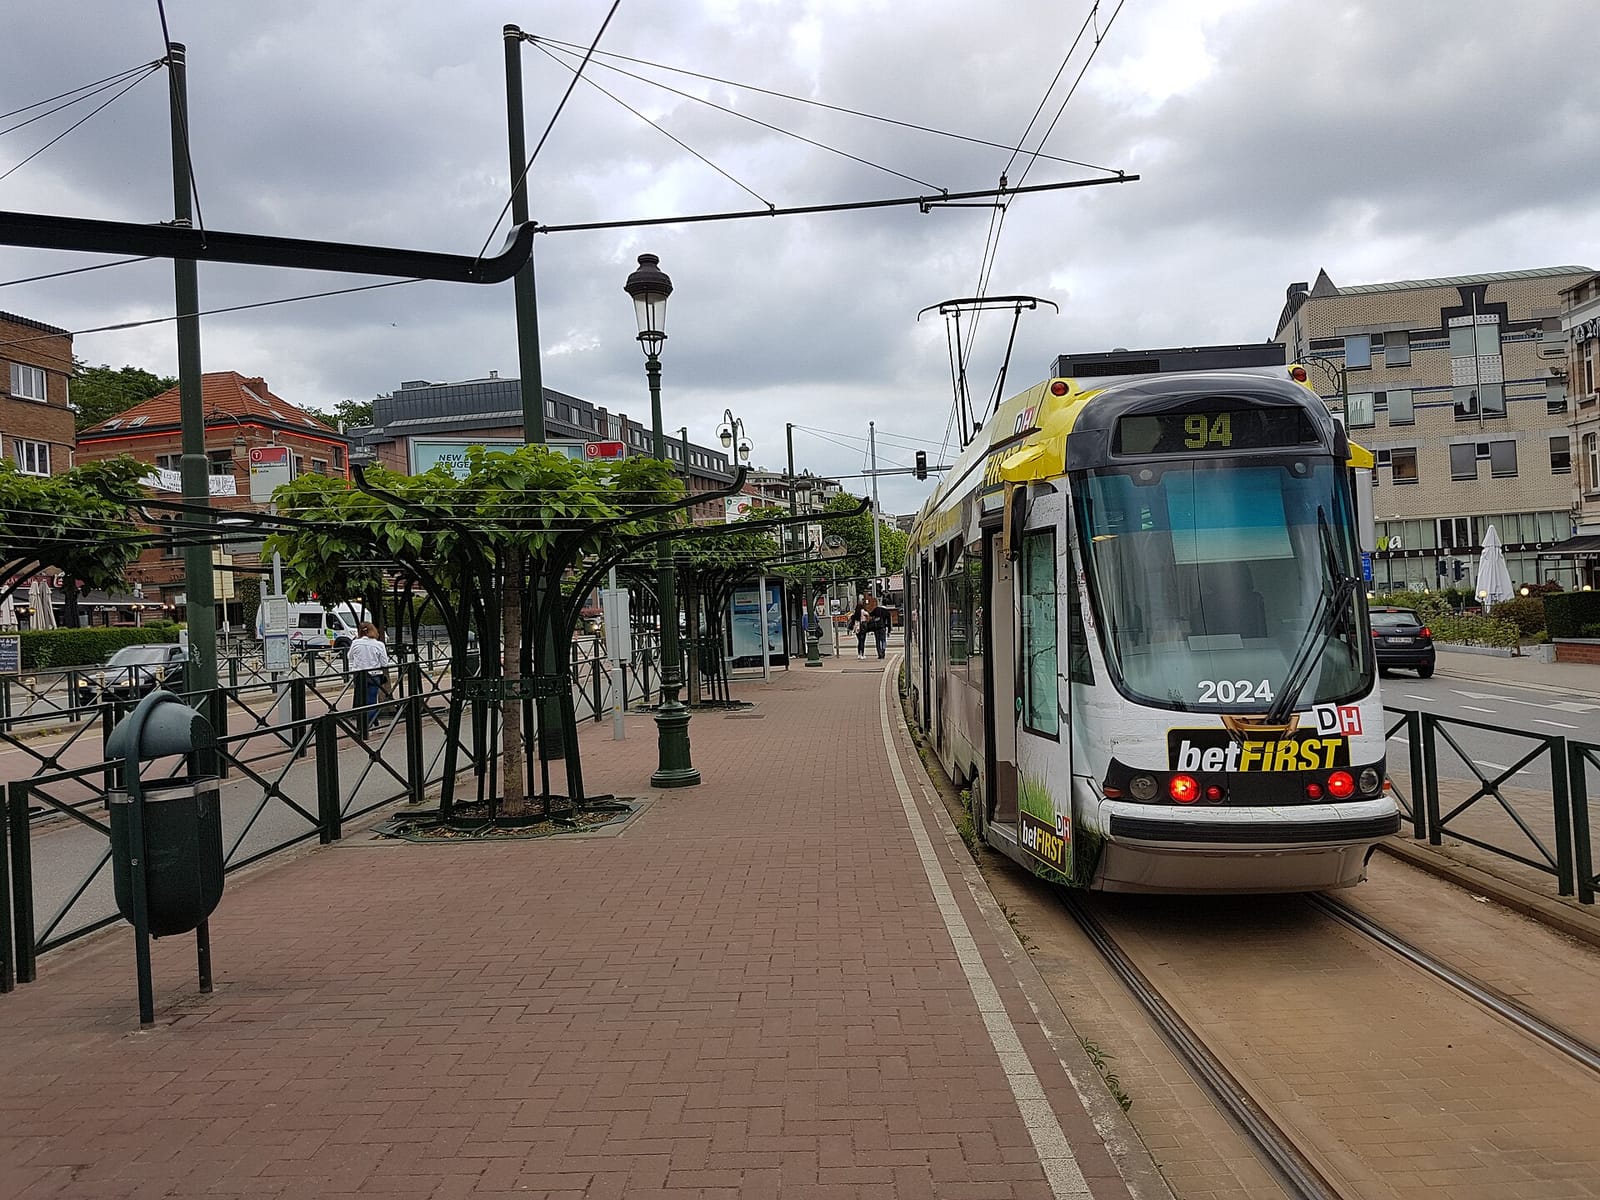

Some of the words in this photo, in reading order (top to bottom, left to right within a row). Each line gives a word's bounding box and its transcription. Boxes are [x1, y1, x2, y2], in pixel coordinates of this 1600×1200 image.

[1185, 413, 1232, 448] 94
[1198, 680, 1274, 703] 2024
[1315, 706, 1361, 734] DH
[1177, 738, 1342, 771] betFIRST
[1022, 820, 1064, 865] betFIRST
[1056, 814, 1071, 841] DH
